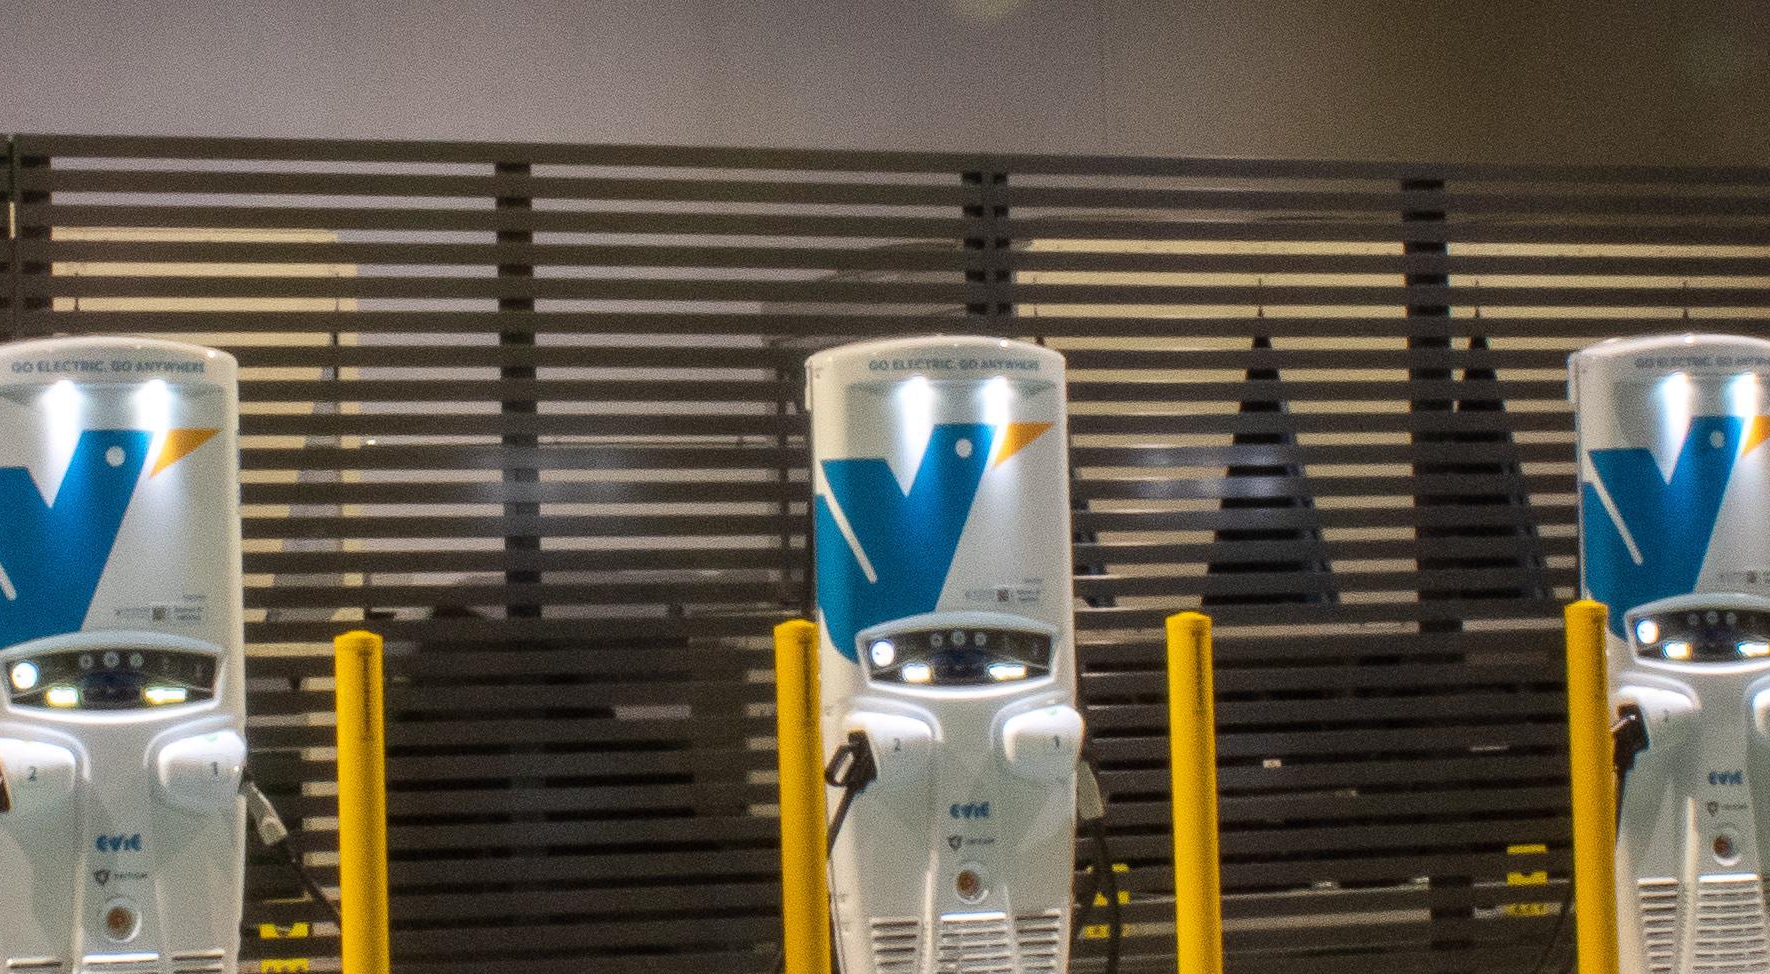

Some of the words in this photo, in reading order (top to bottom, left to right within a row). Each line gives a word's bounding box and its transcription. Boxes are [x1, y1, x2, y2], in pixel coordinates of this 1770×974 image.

[10, 361, 34, 374] GO
[111, 360, 132, 373] GO
[868, 359, 889, 371] GO
[959, 359, 978, 370] GO
